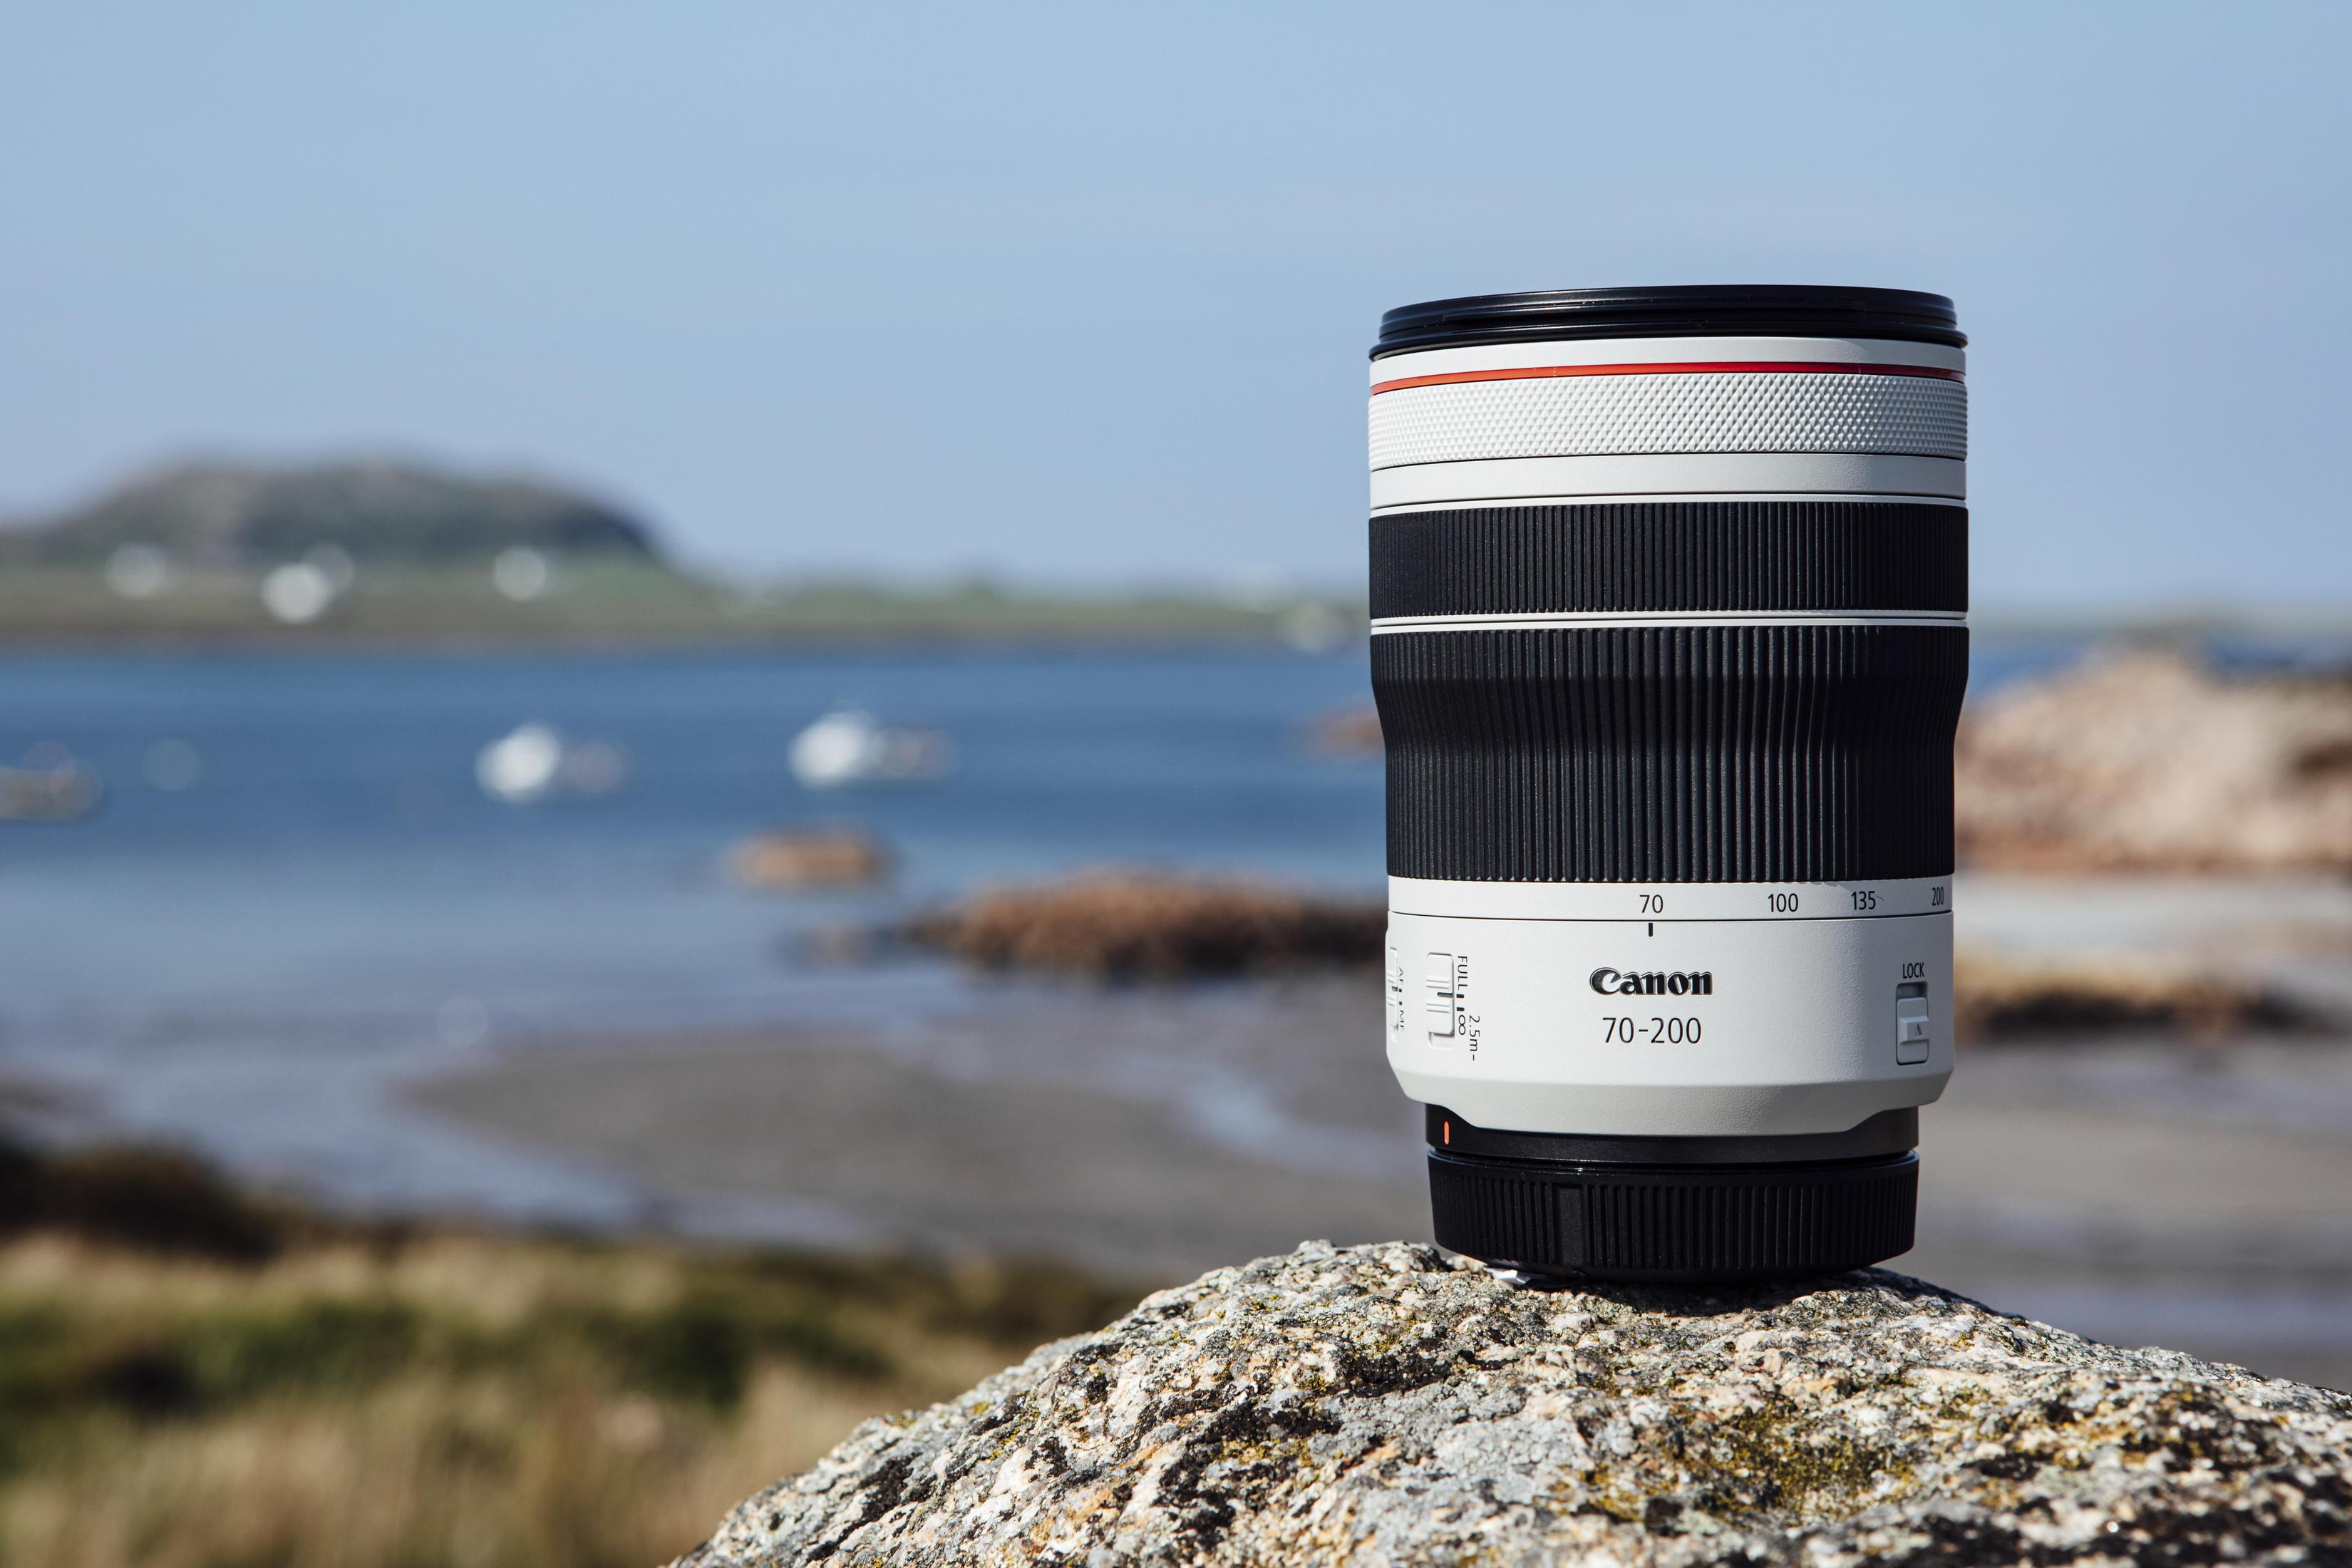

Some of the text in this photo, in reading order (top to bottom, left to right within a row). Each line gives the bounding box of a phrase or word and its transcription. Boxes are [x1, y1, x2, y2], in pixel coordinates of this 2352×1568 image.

[1639, 887, 1944, 913] 70 100 135 200
[1458, 956, 1468, 990] FULL
[1589, 967, 1713, 996] Canon
[1902, 962, 1925, 979] LOCK
[1602, 1017, 1701, 1044] 70-200
